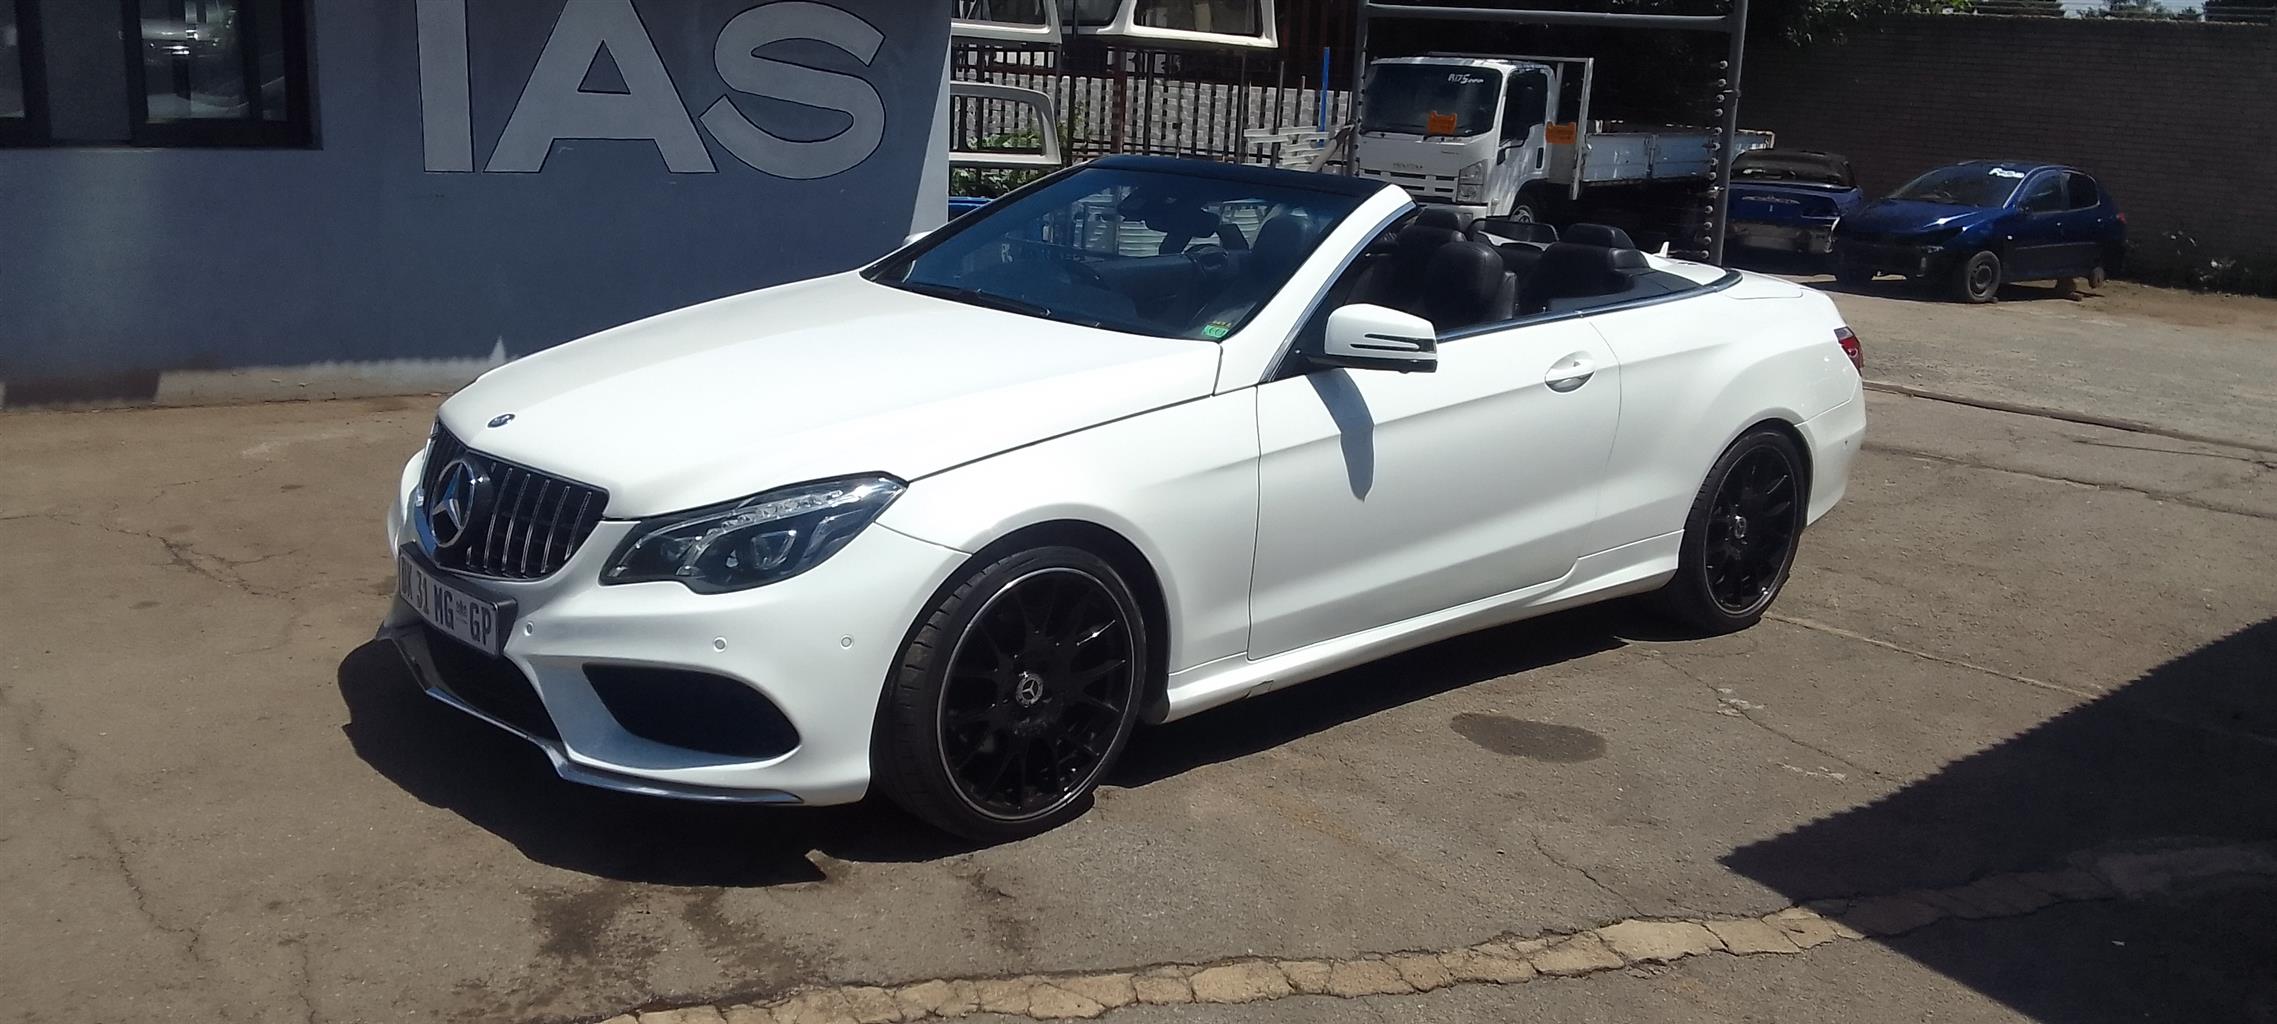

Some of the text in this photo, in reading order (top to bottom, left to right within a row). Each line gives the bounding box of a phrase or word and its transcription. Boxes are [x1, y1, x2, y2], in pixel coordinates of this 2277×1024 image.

[416, 570, 430, 615] 31
[433, 584, 455, 630] MG
[469, 602, 492, 646] GP
